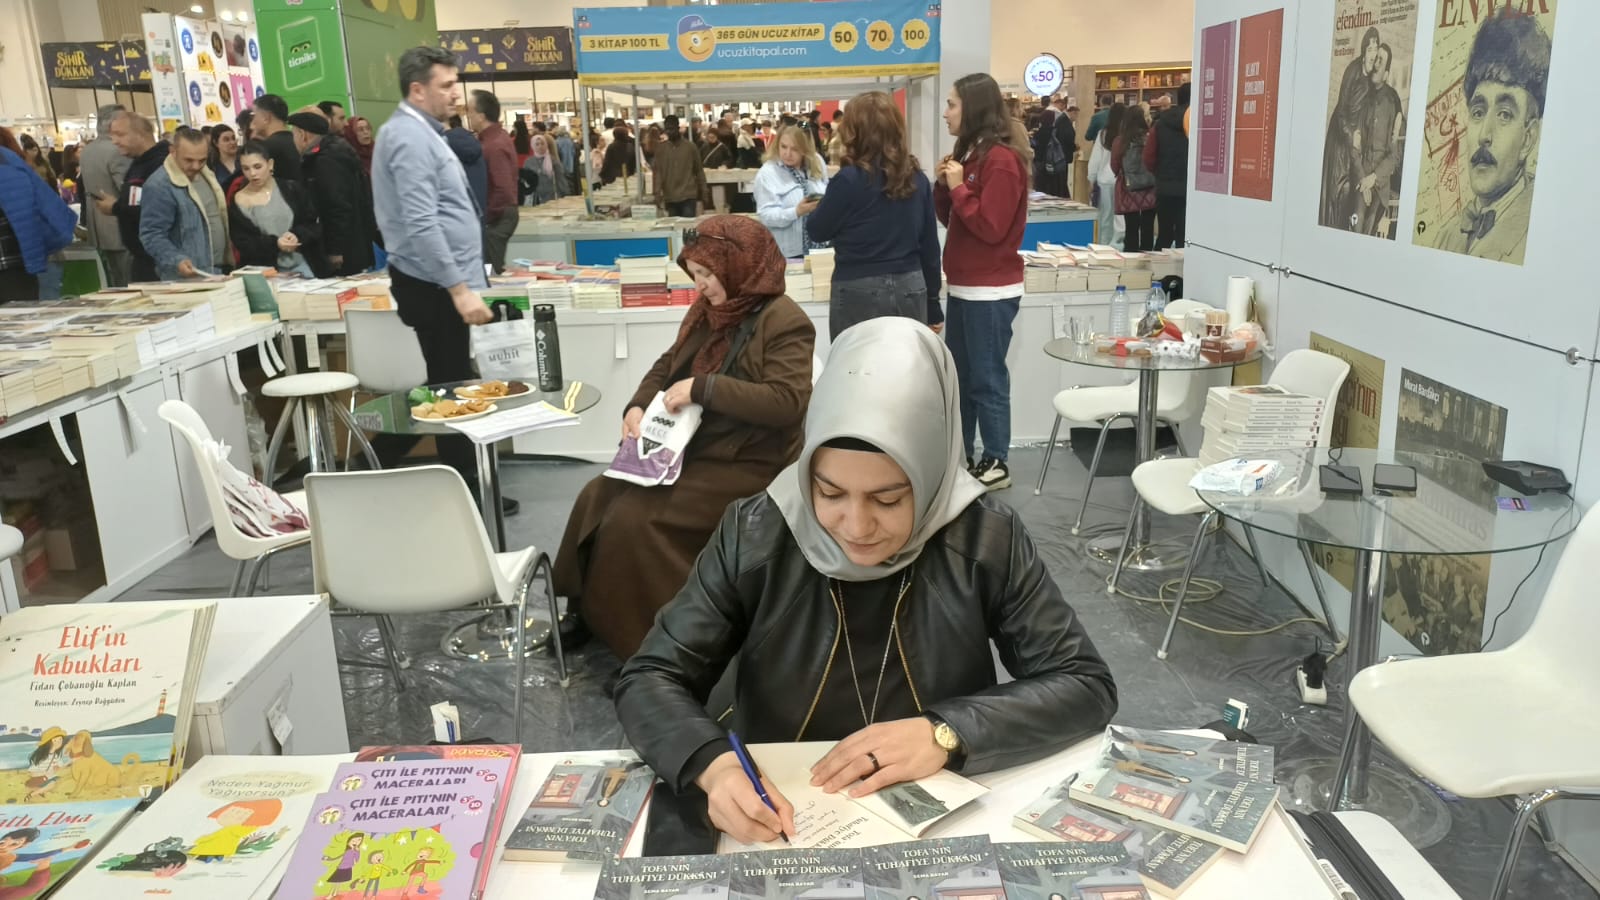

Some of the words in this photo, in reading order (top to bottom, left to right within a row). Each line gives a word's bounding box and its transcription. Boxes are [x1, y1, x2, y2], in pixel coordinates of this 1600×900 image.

[716, 29, 736, 40] 365
[737, 28, 759, 39] GÜN
[761, 29, 789, 39] UCUZ
[791, 27, 820, 38] KİTAP
[589, 40, 596, 48] 3
[597, 37, 628, 48] KİTAP
[630, 38, 647, 47] 100
[649, 38, 661, 47] TL
[717, 46, 807, 59] ucuzkitapal.com
[537, 340, 549, 386] Columbia
[58, 625, 128, 650] Elif'in
[33, 651, 143, 676] Kabukları
[30, 681, 55, 691] Fidan
[58, 679, 105, 692] Çobanoğlu
[107, 678, 137, 690] Kaplan
[371, 769, 397, 779] ÇITI
[400, 766, 419, 777] İLE
[423, 766, 475, 776] PITI'NIN
[374, 777, 467, 790] MACERALARI
[350, 798, 376, 810] ÇITI
[380, 795, 400, 807] İLE
[403, 793, 458, 804] PITI'NIN
[352, 806, 450, 821] MACERALARI
[902, 846, 952, 858] TOFA'NIN
[1035, 848, 1088, 857] TOFA'NIN
[771, 856, 821, 866] TOFA'NIN
[641, 863, 691, 873] TOFA'NIN
